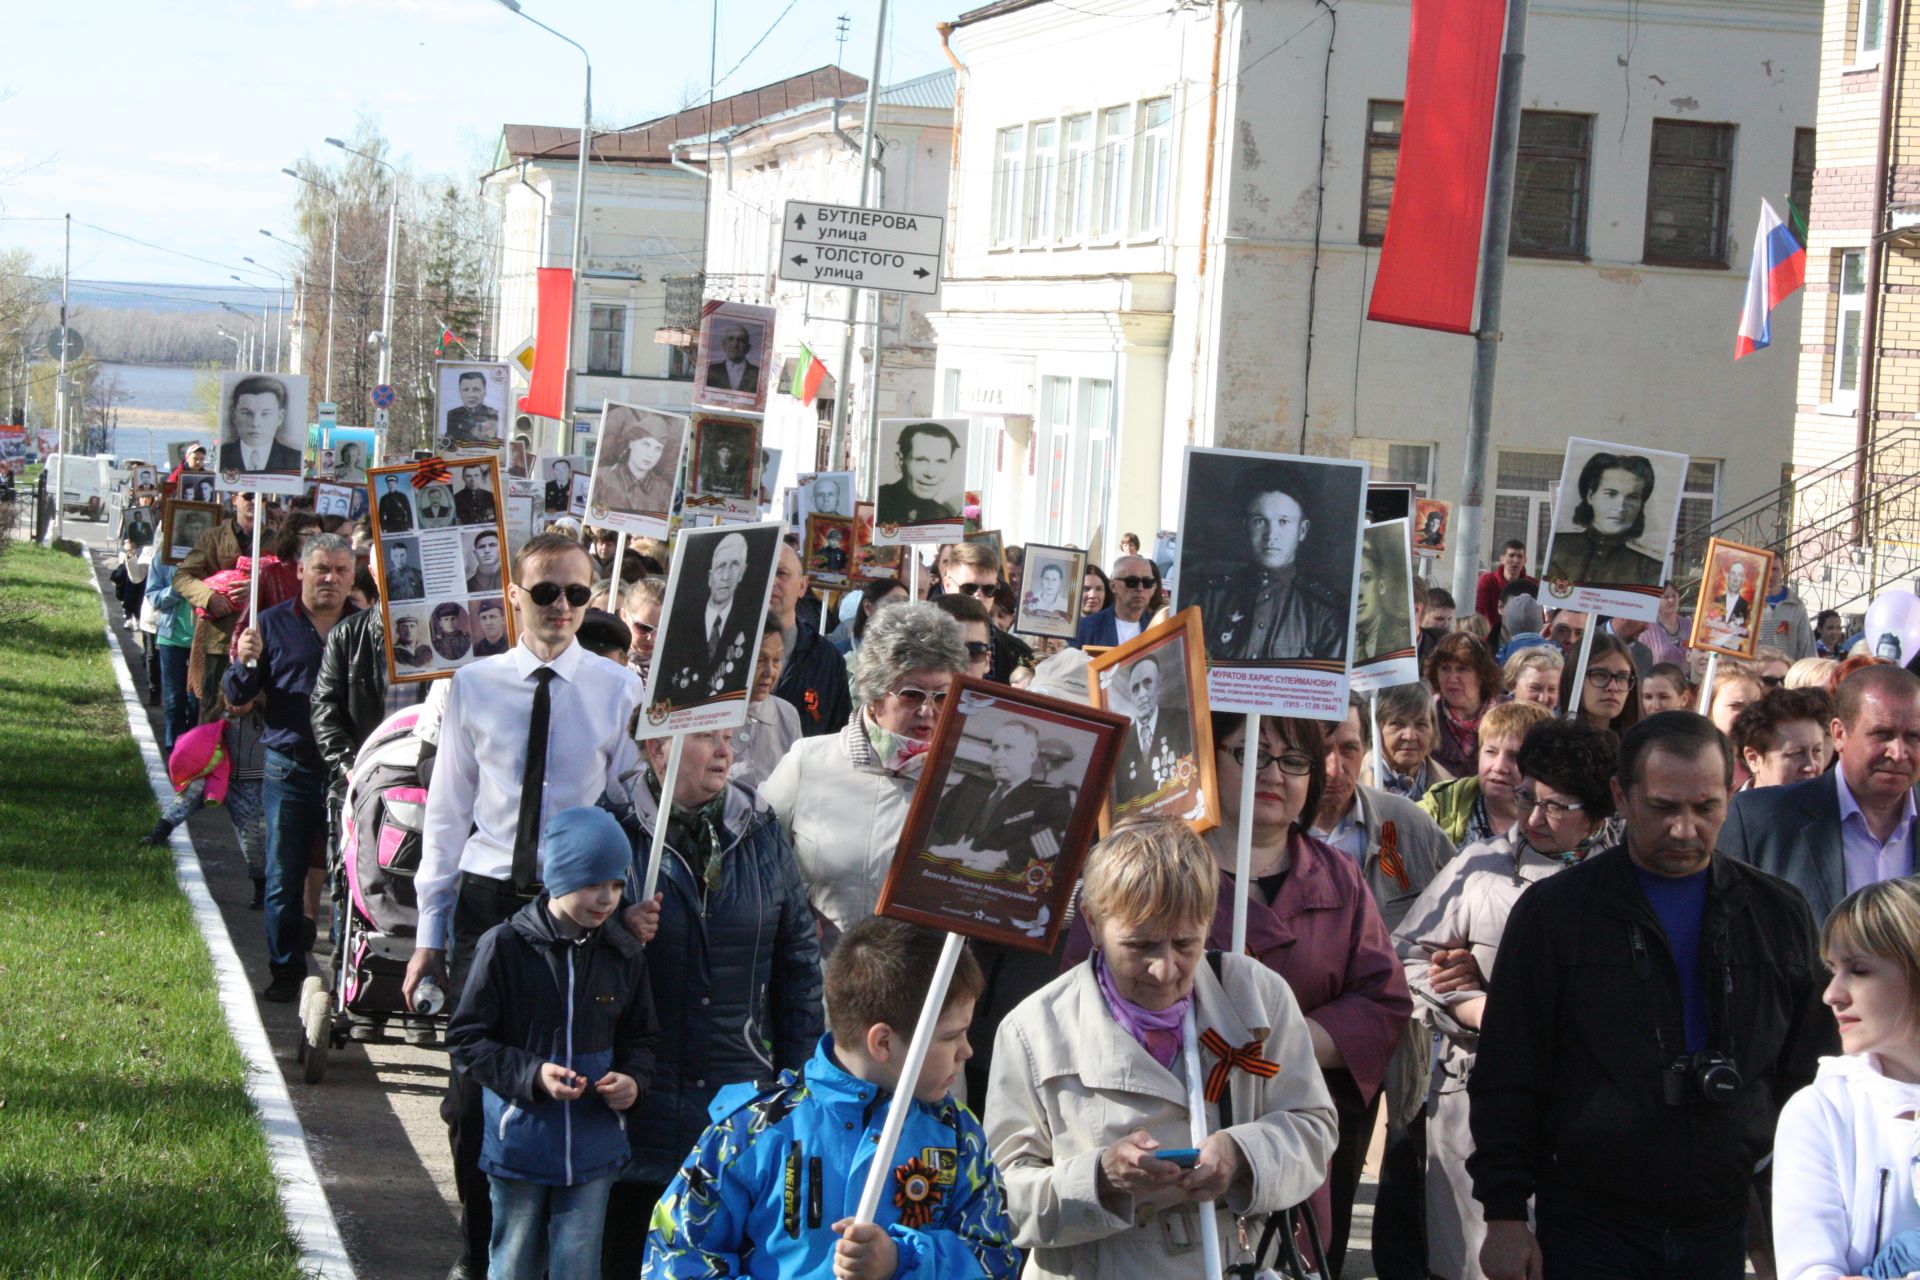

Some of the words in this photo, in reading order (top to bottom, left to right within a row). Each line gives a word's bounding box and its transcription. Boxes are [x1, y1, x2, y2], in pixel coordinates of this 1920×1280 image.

[817, 208, 918, 231] БУТЛЕРОВА
[818, 226, 868, 242] улица
[815, 246, 905, 268] ТОЛСТОГО
[814, 265, 864, 281] улица
[1211, 670, 1247, 681] МУРАТОВ
[1248, 673, 1274, 683] ХАРИС
[1274, 674, 1337, 688] СУЛЕЙМАНОВИЧ
